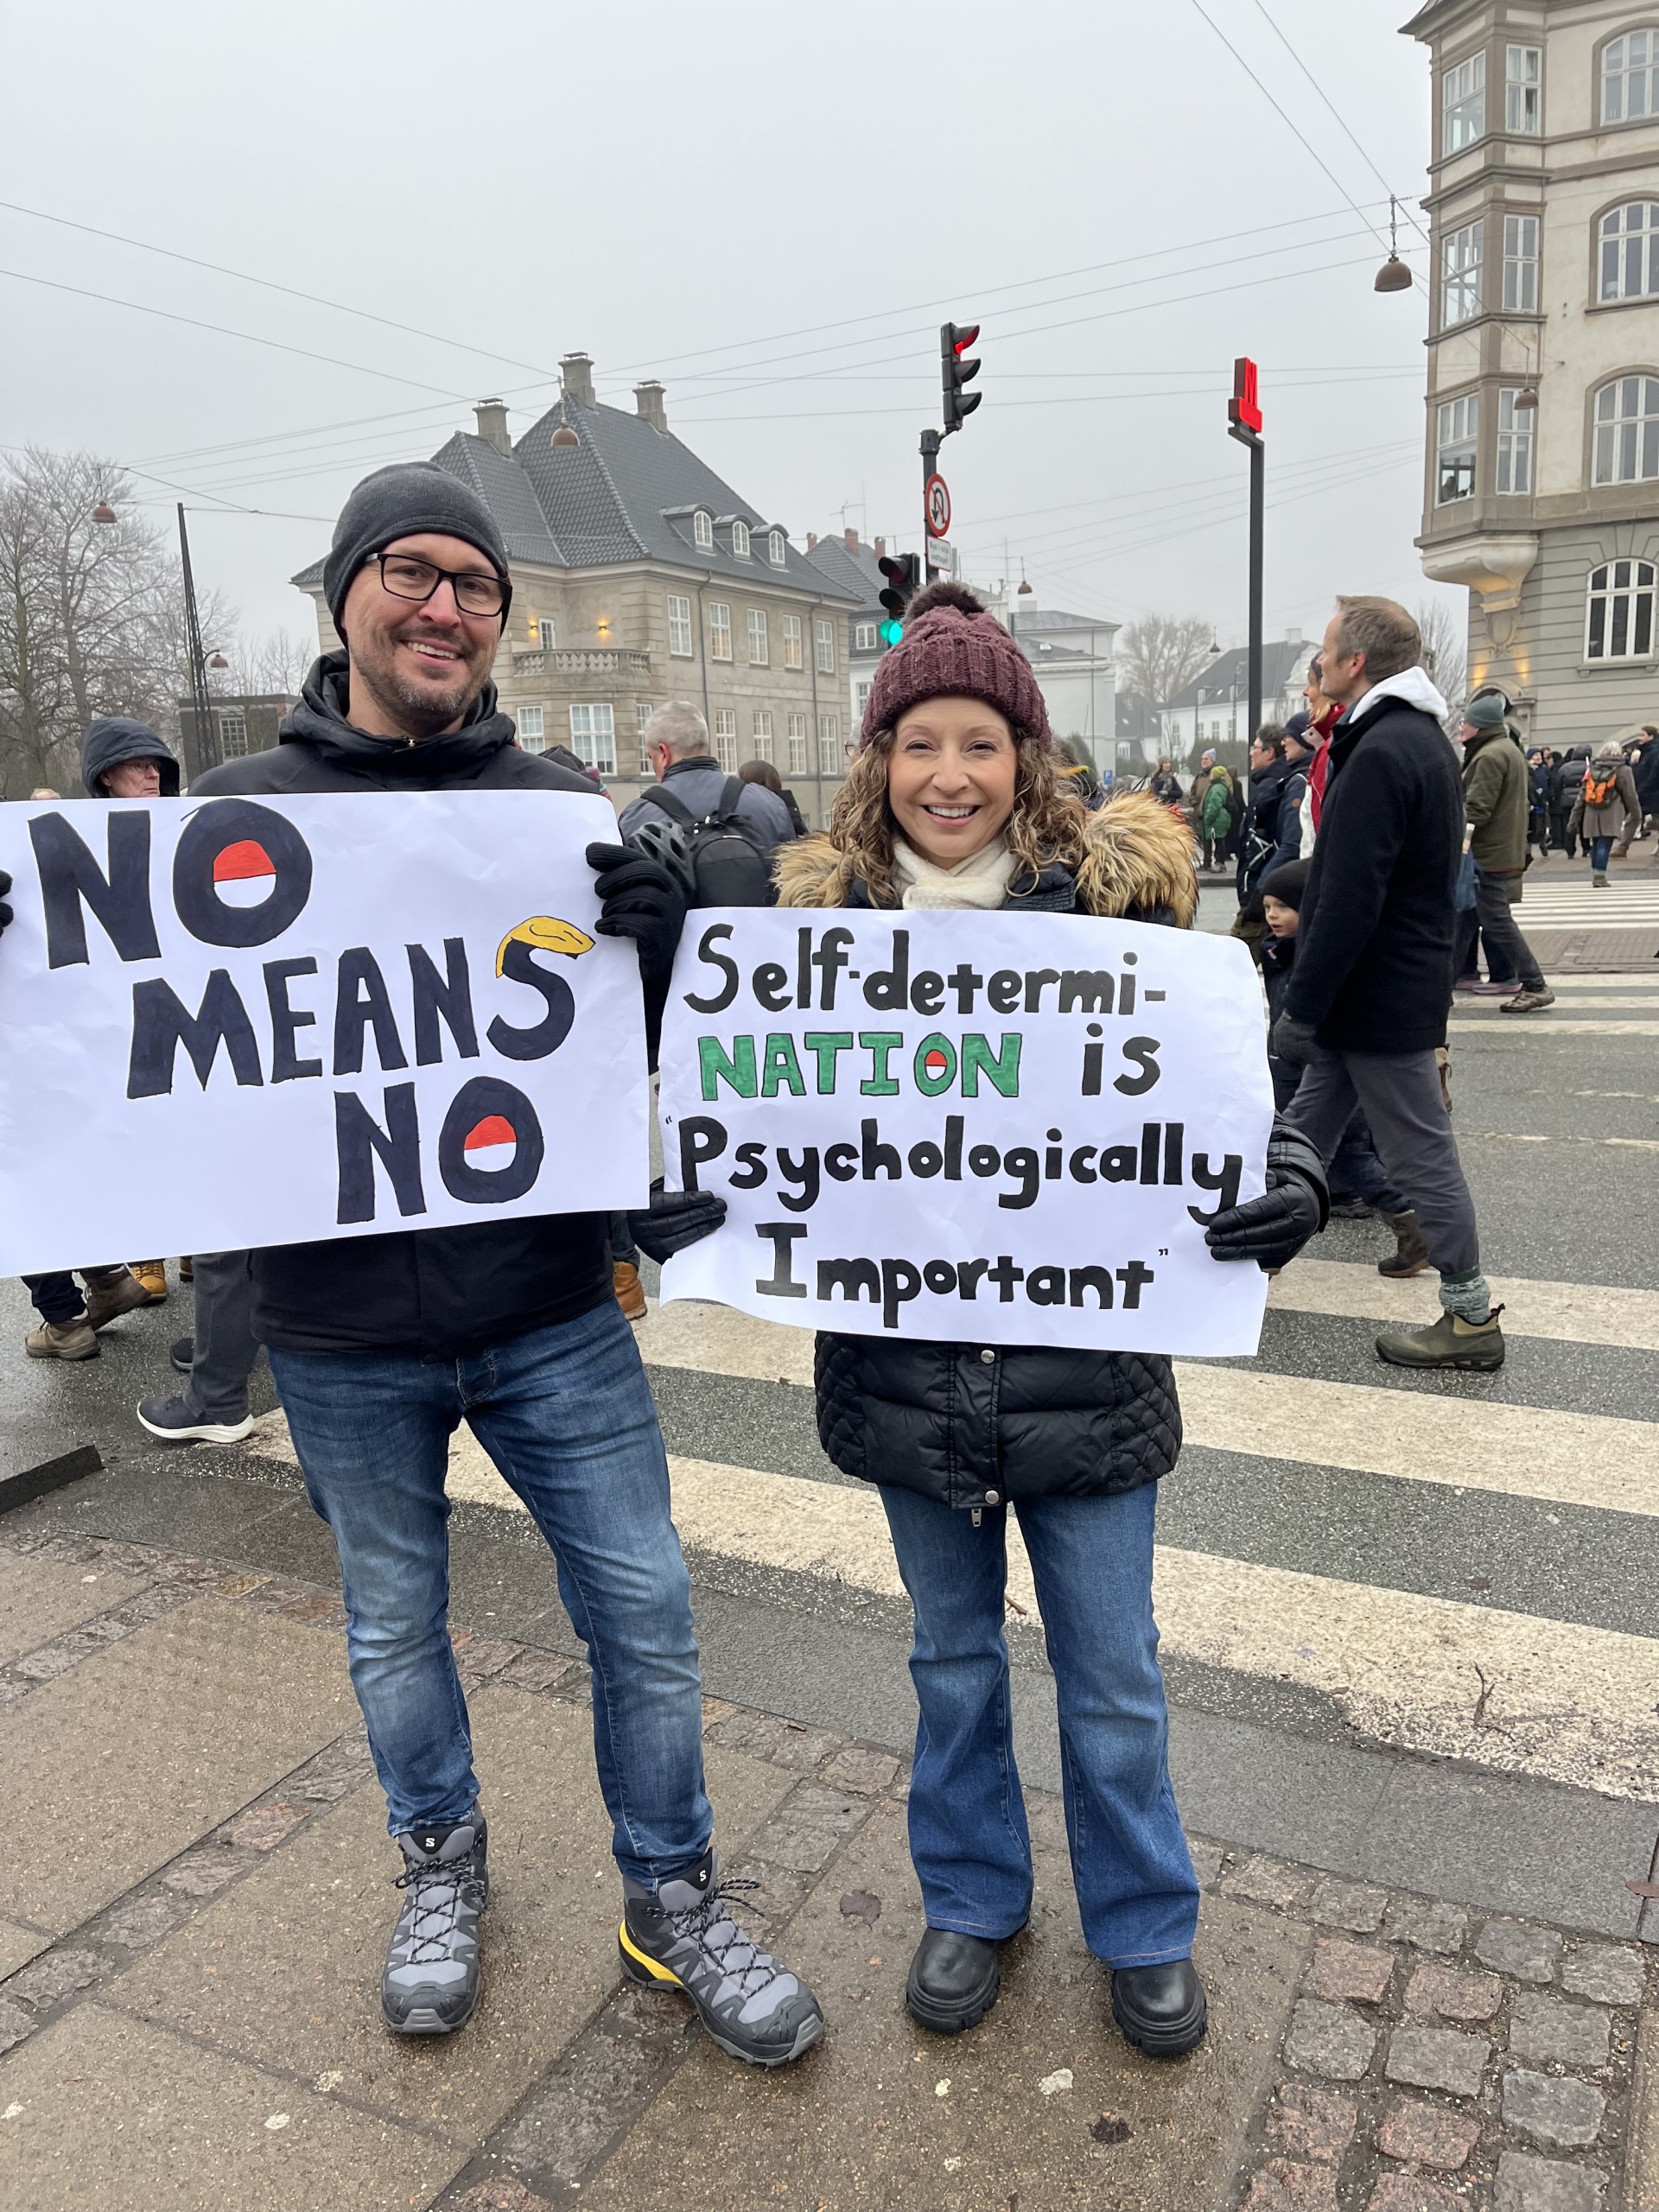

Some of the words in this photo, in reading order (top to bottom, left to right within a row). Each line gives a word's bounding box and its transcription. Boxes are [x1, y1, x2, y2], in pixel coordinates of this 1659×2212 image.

[27, 798, 313, 969] NO
[126, 916, 596, 1098] MEANS
[683, 923, 1166, 1015] Self-determi-
[697, 1032, 1022, 1101] NATION
[1081, 1023, 1161, 1096] is
[334, 1076, 544, 1224] NO
[755, 1222, 1168, 1328] Important"
[425, 1837, 435, 1847] S
[699, 1869, 707, 1882] S
